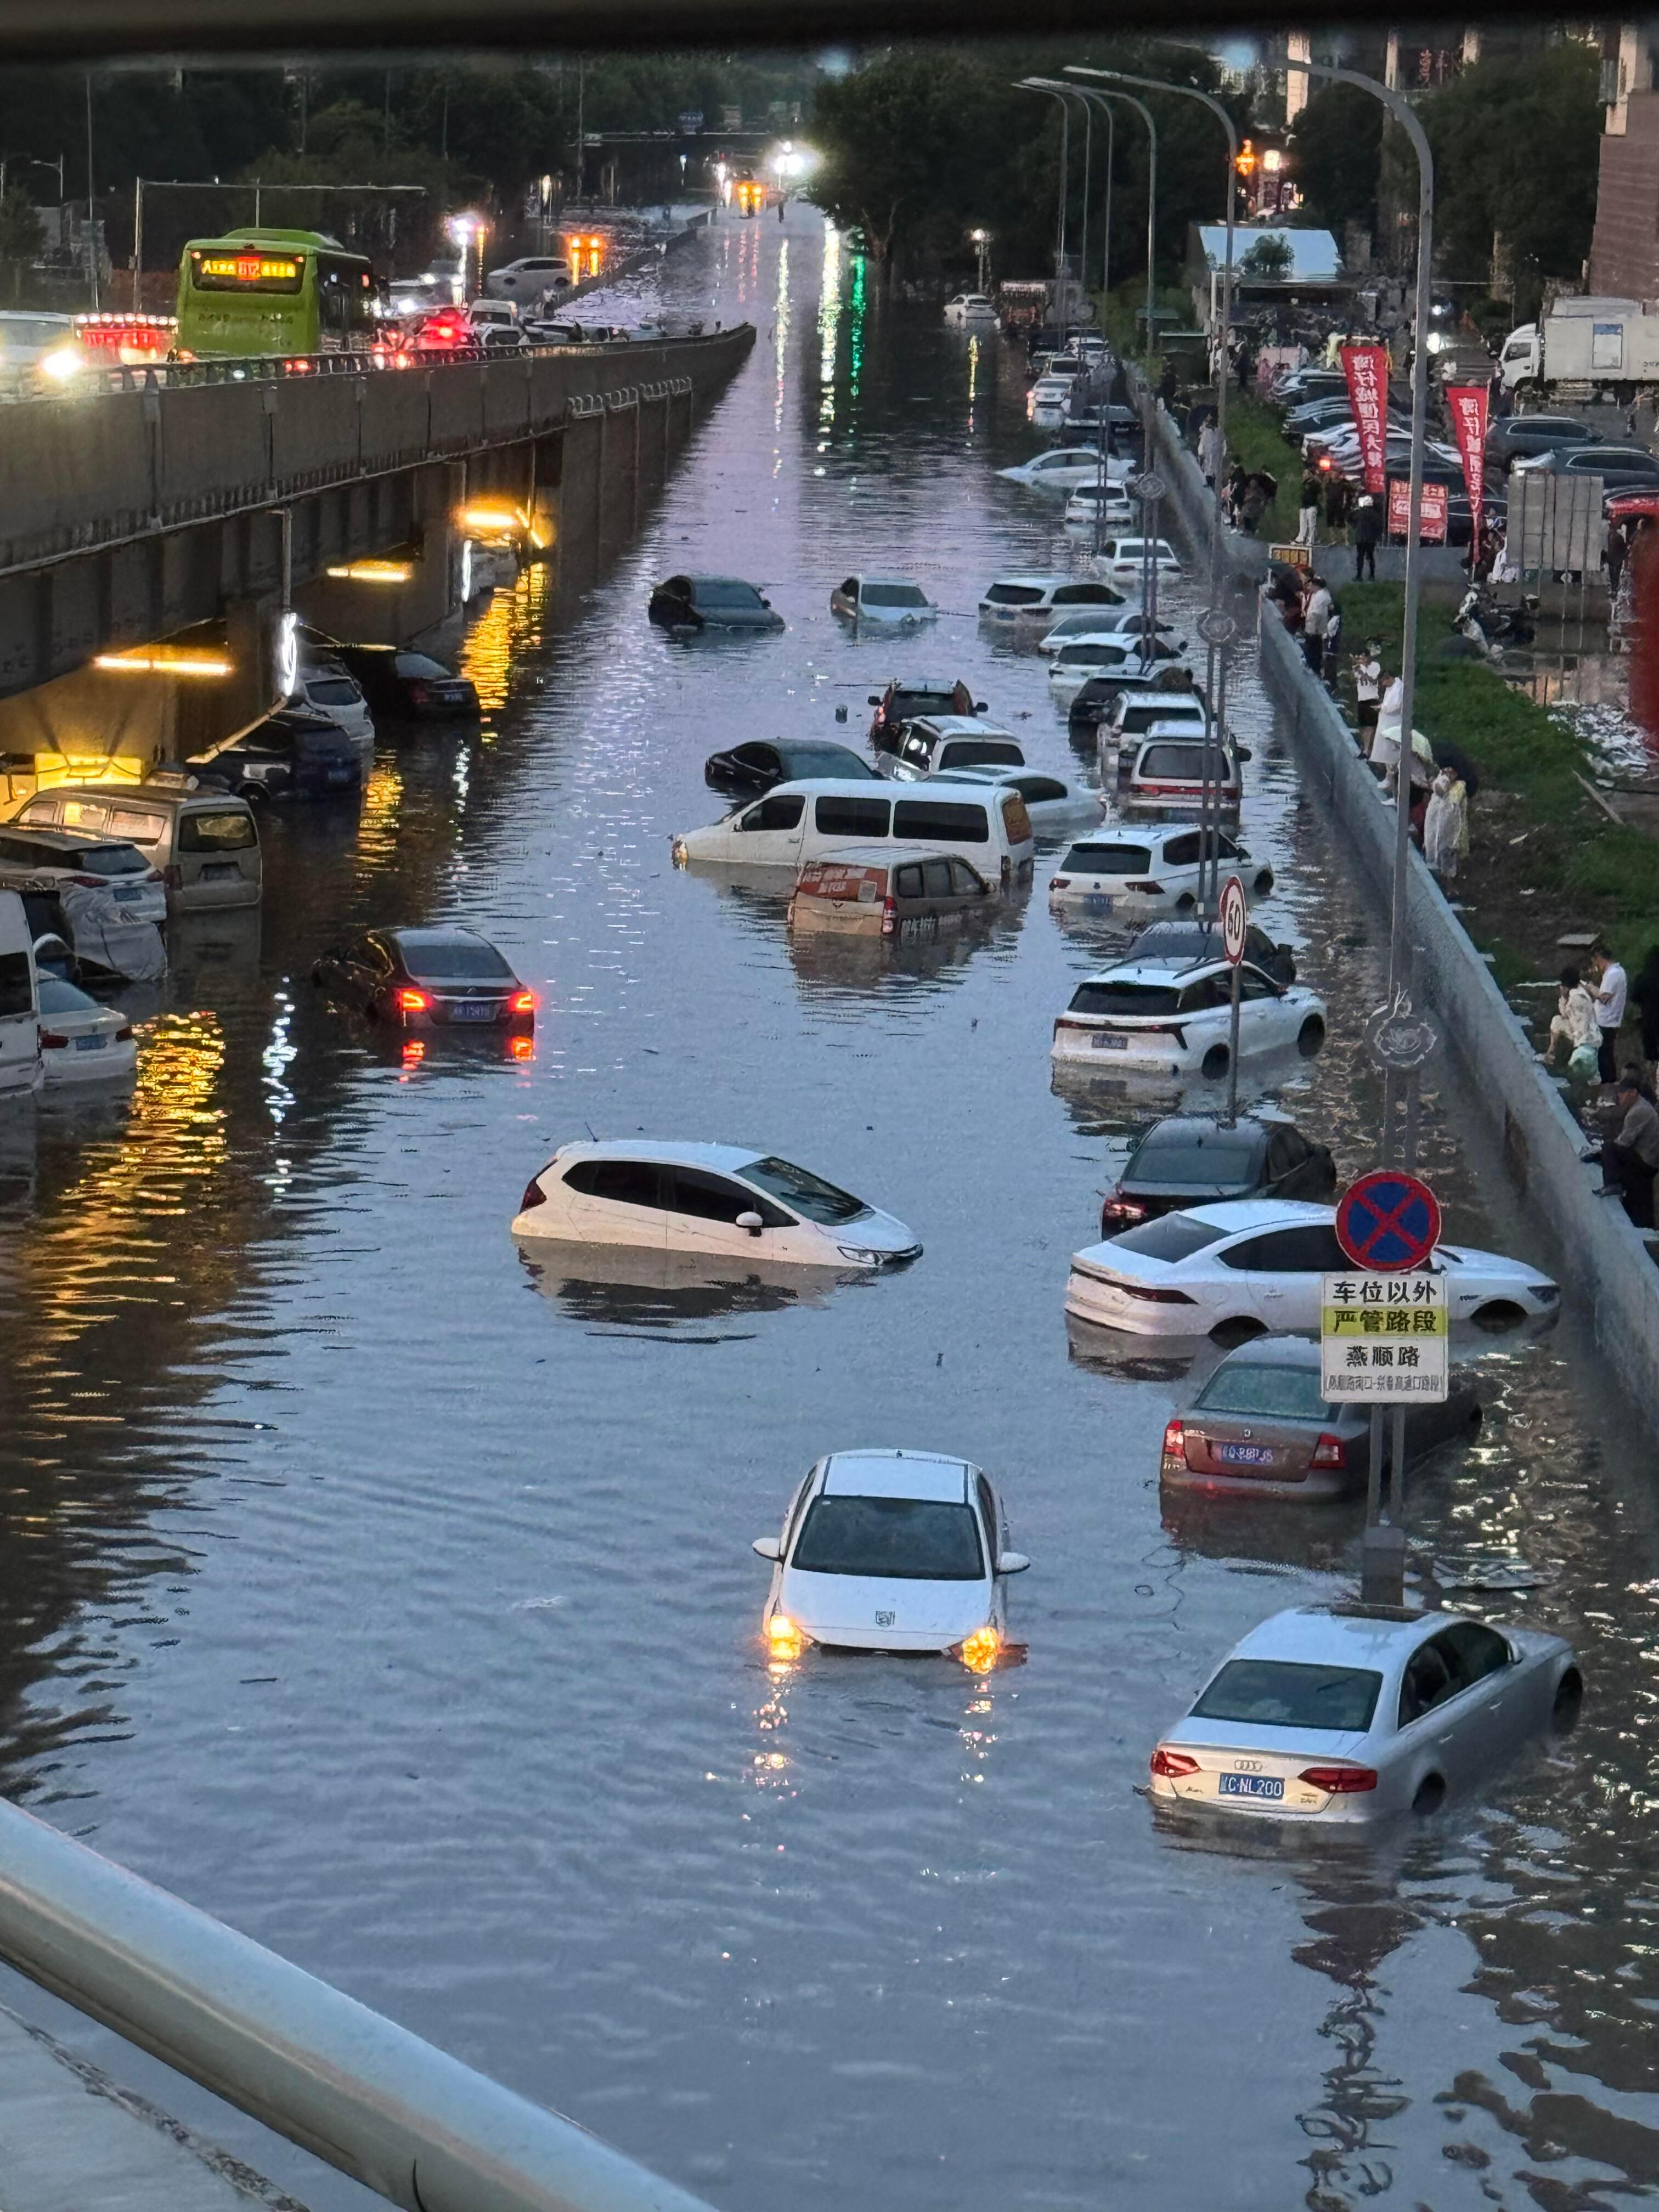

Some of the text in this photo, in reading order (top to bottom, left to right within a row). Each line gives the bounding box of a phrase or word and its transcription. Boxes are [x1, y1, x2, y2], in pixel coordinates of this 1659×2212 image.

[1228, 900, 1240, 940] 60
[1333, 1280, 1437, 1304] 车位以外
[1334, 1310, 1436, 1332] 严管路段
[1346, 1345, 1420, 1368] 燕顺路
